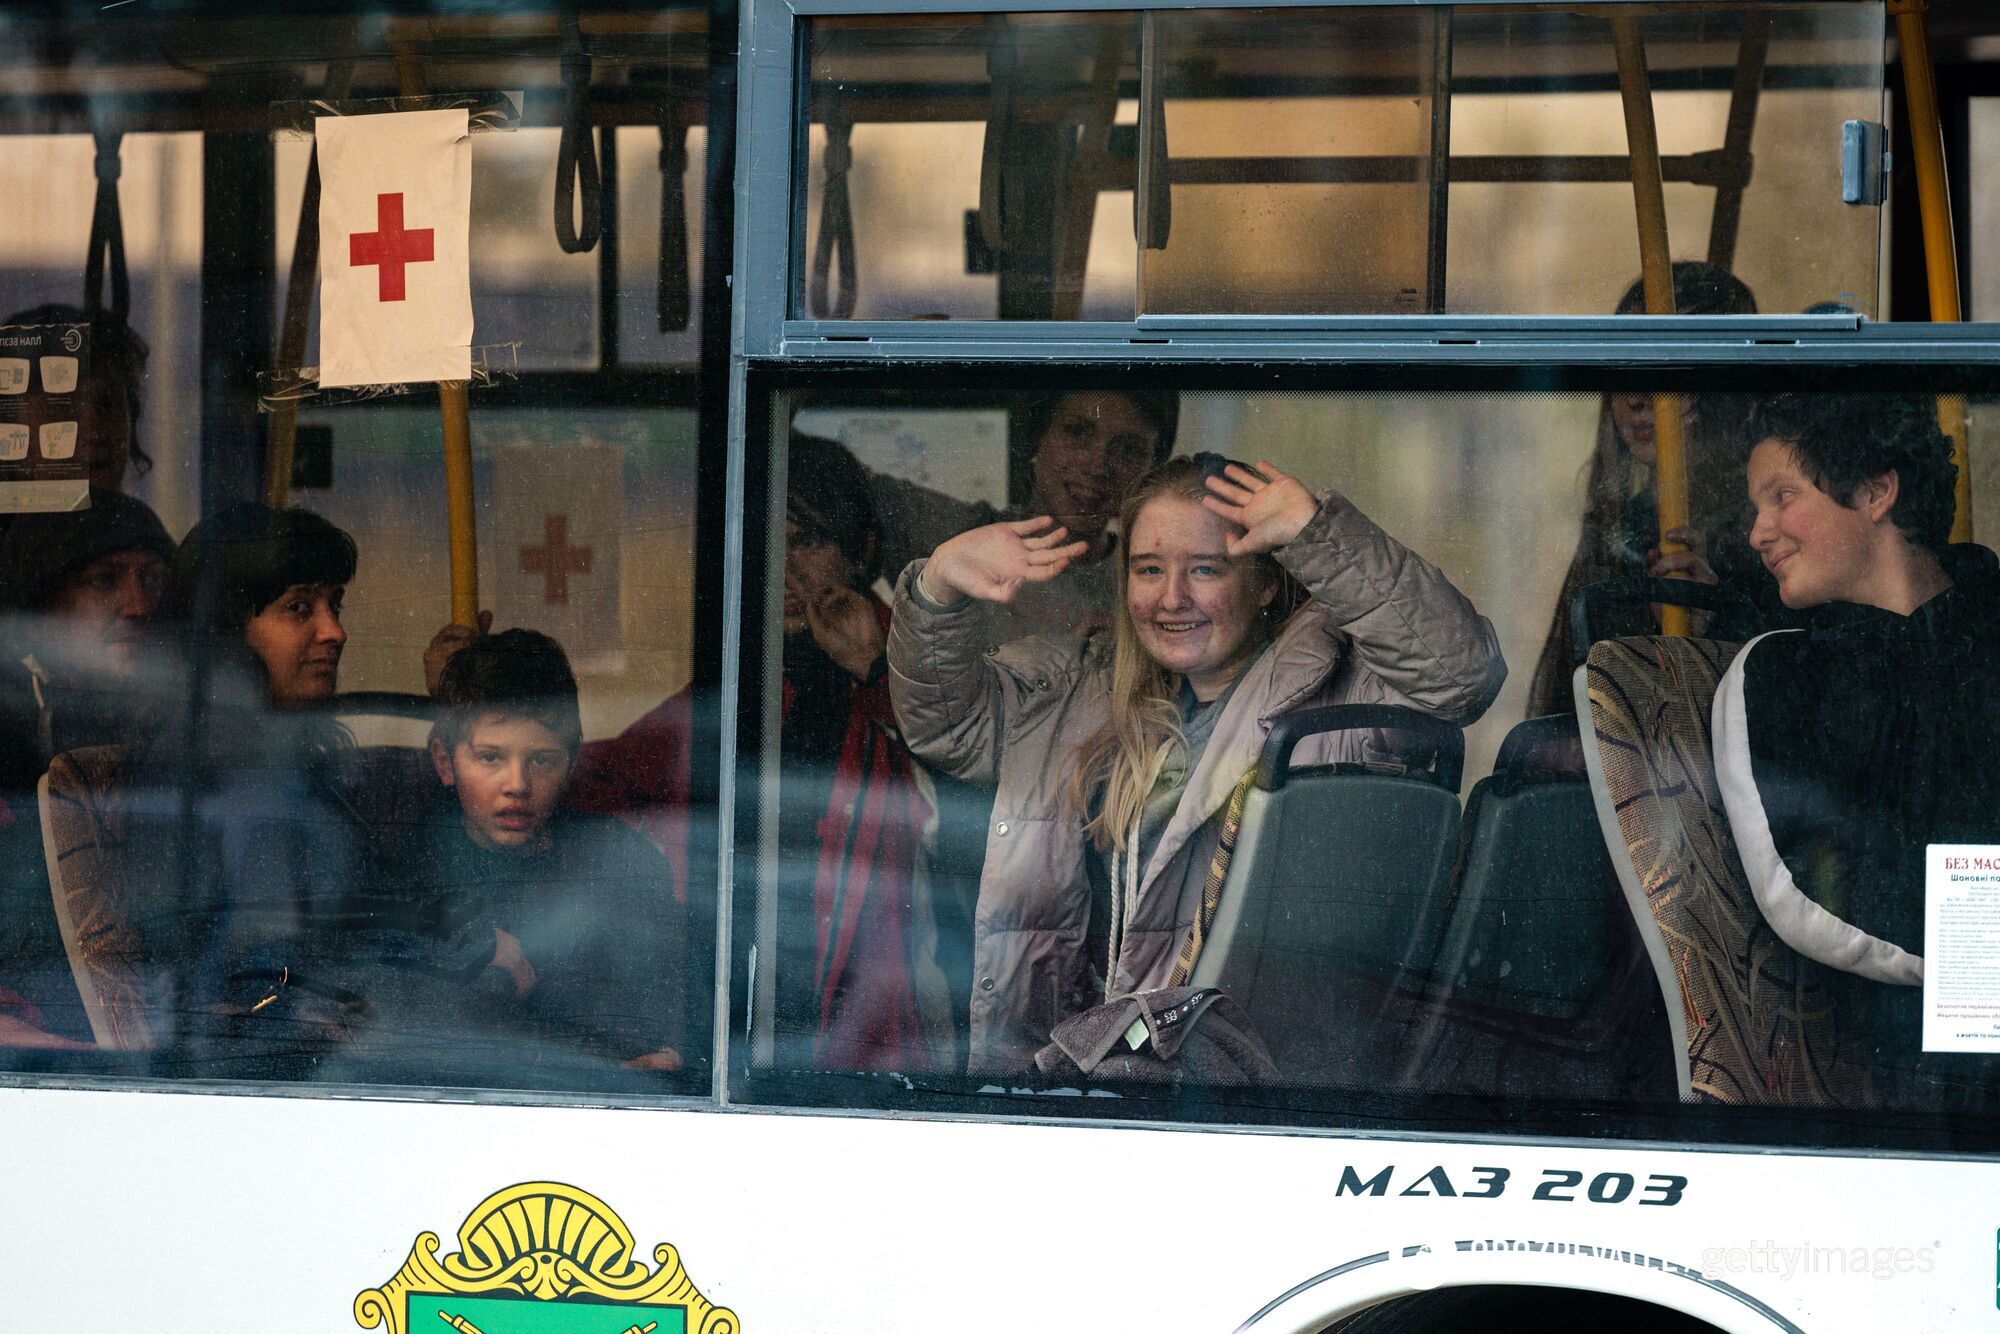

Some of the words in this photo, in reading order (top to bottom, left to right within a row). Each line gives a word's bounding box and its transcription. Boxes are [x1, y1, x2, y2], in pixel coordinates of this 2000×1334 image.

[1945, 857, 1969, 870] БЕЗ
[1951, 874, 1988, 882] Шановні
[1335, 1165, 1511, 1198] МАЗ
[1532, 1169, 1688, 1206] 203
